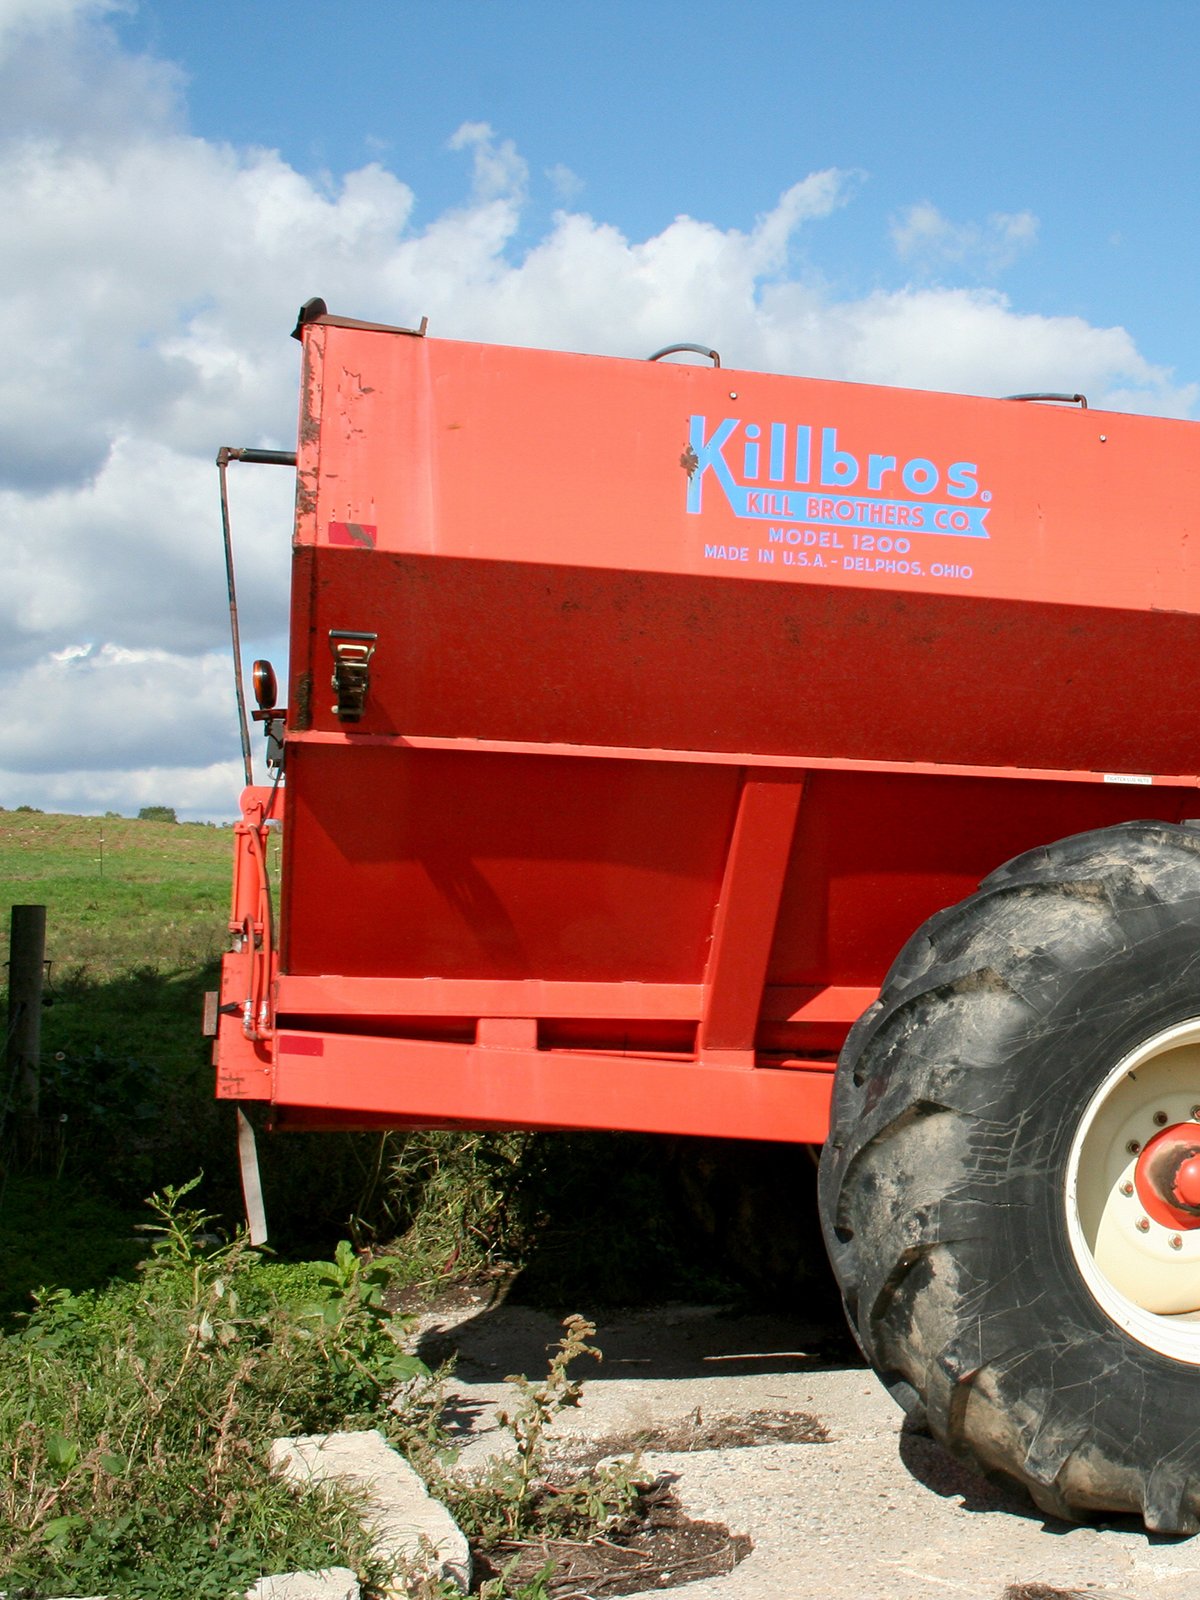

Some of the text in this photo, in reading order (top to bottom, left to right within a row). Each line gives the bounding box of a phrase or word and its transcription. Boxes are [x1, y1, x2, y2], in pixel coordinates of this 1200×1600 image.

[746, 491, 972, 532] KILL BROTHERS CO.
[768, 527, 911, 554] MODEL 1200
[704, 544, 749, 562] MADE
[758, 548, 774, 564] IN
[930, 562, 973, 579] OHIO
